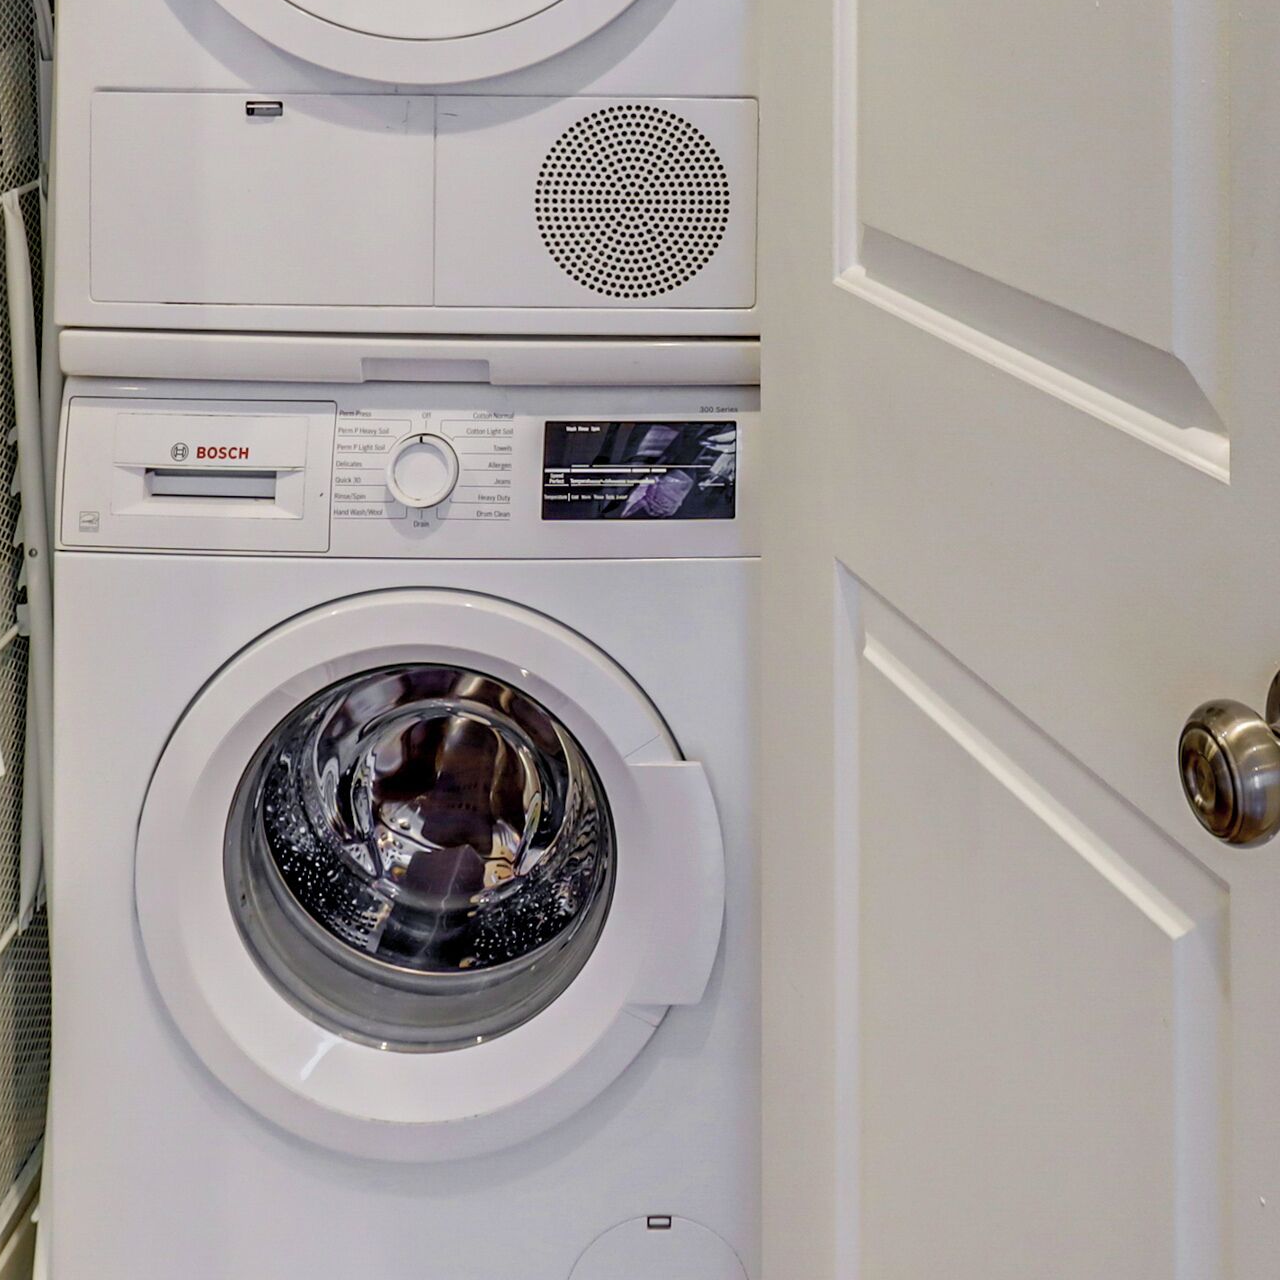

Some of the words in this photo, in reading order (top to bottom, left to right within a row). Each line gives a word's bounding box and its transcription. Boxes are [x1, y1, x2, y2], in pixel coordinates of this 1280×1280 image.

[421, 411, 431, 419] Off
[487, 428, 502, 437] Light
[358, 444, 373, 453] Light
[196, 447, 250, 460] BOSCH
[488, 462, 513, 470] Allergen
[496, 495, 511, 503] Duty
